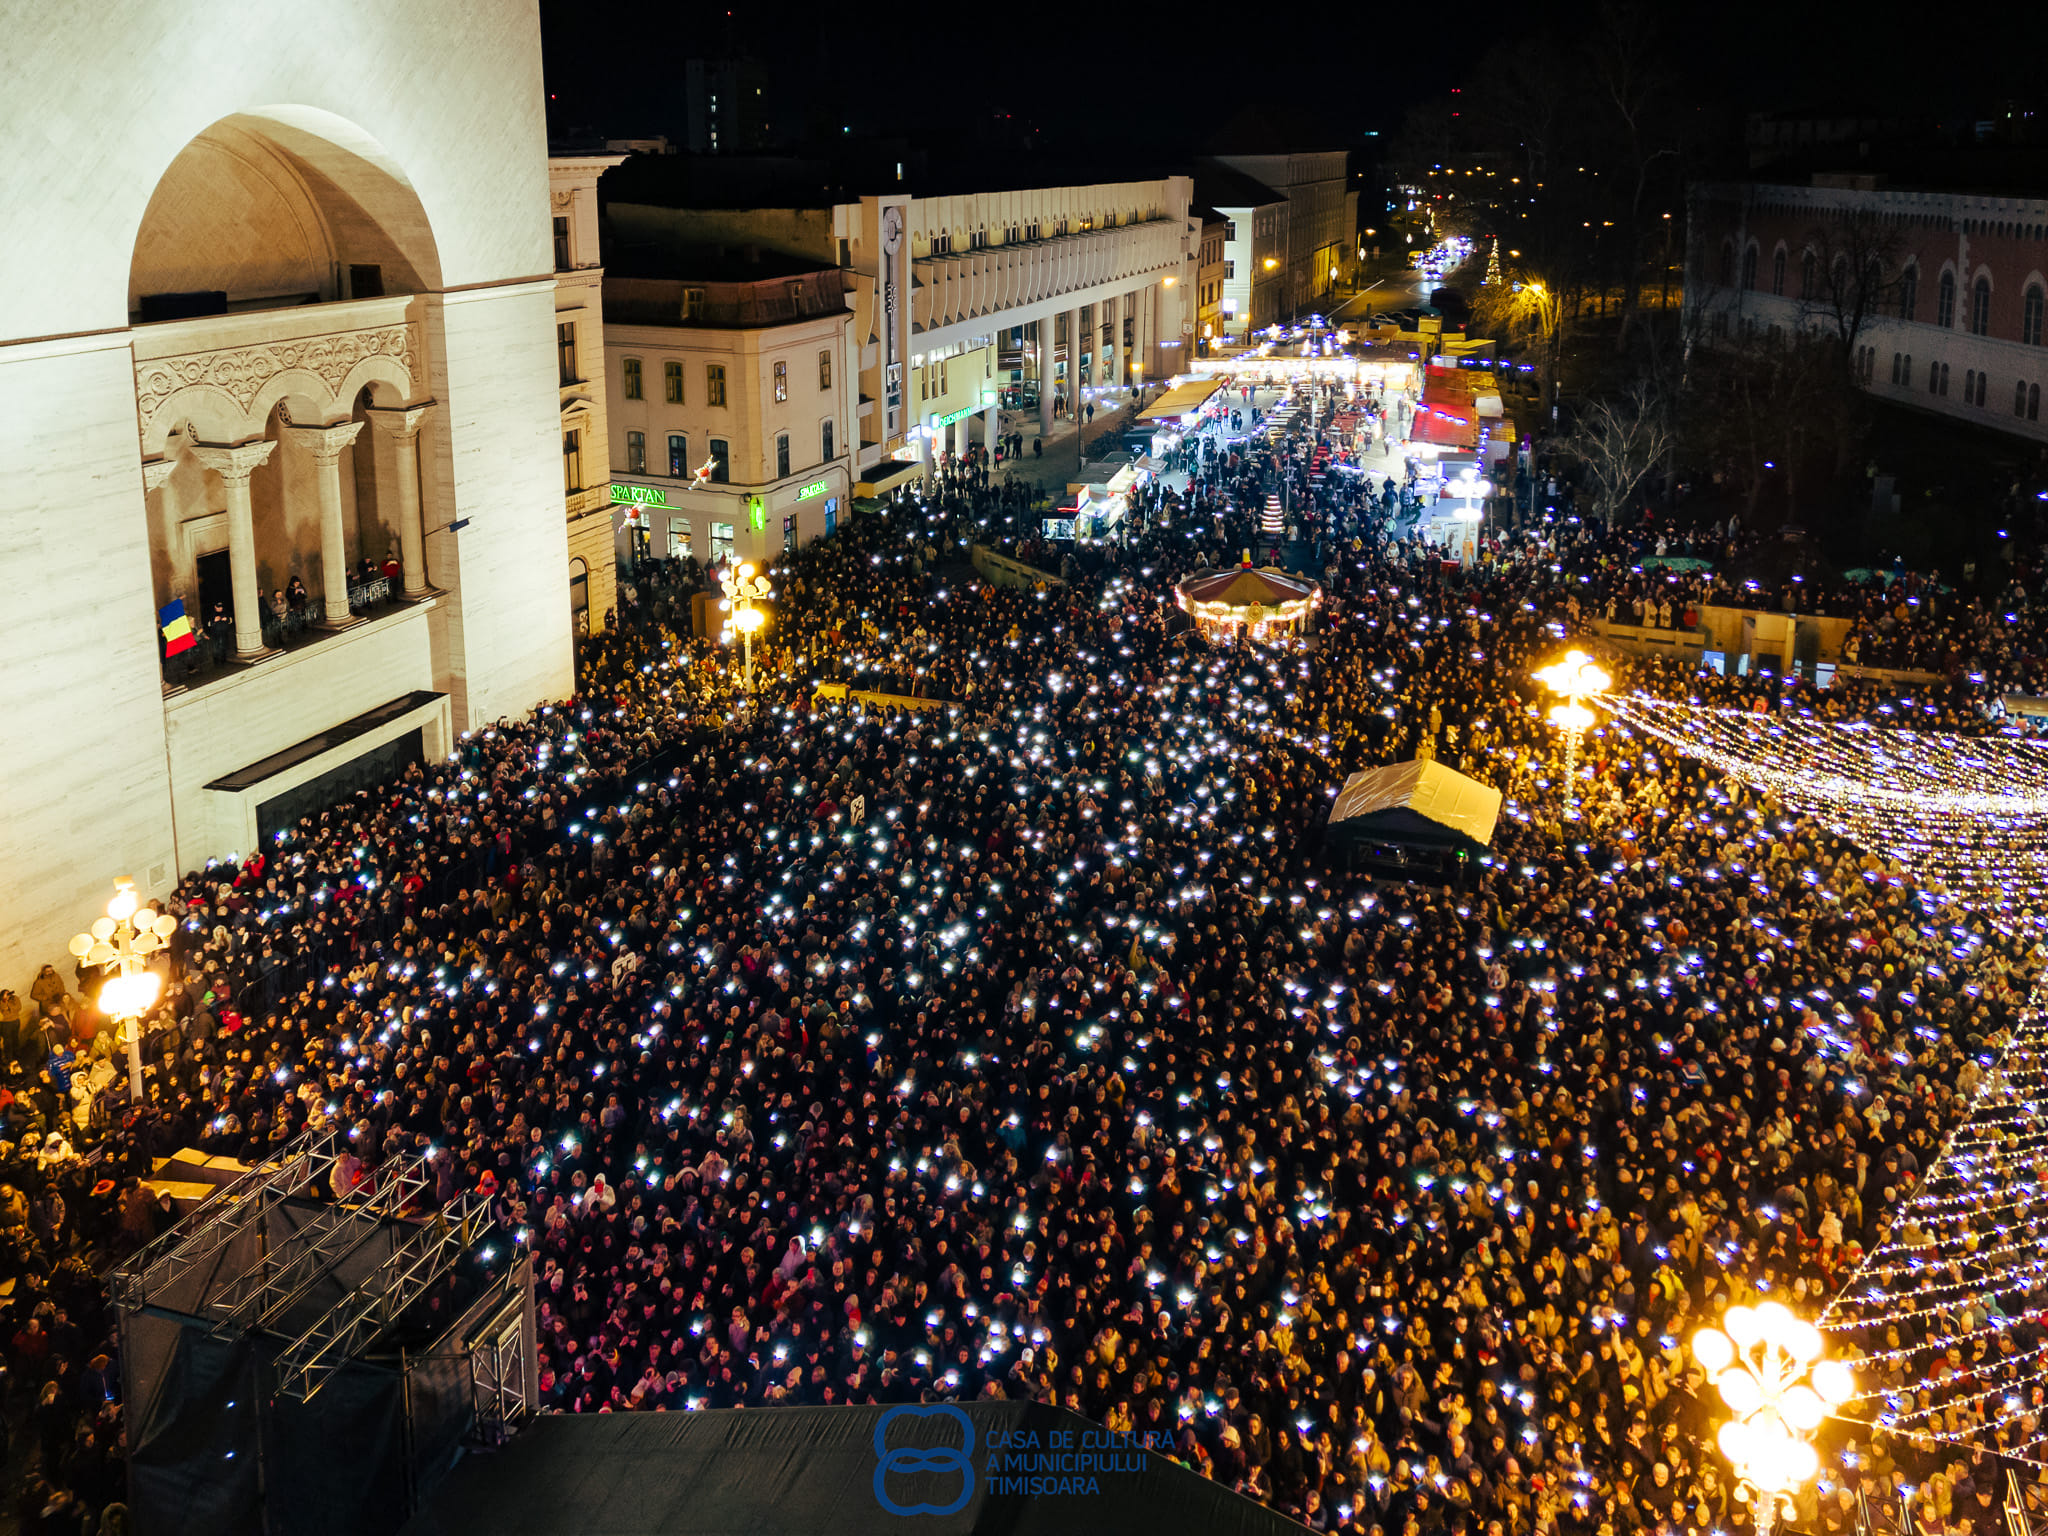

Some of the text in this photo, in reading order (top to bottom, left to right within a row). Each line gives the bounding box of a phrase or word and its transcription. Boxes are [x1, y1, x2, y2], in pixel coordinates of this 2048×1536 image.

[939, 406, 972, 428] DEICHMANN
[610, 484, 666, 504] SPARTAN
[799, 480, 826, 499] SPARTAN
